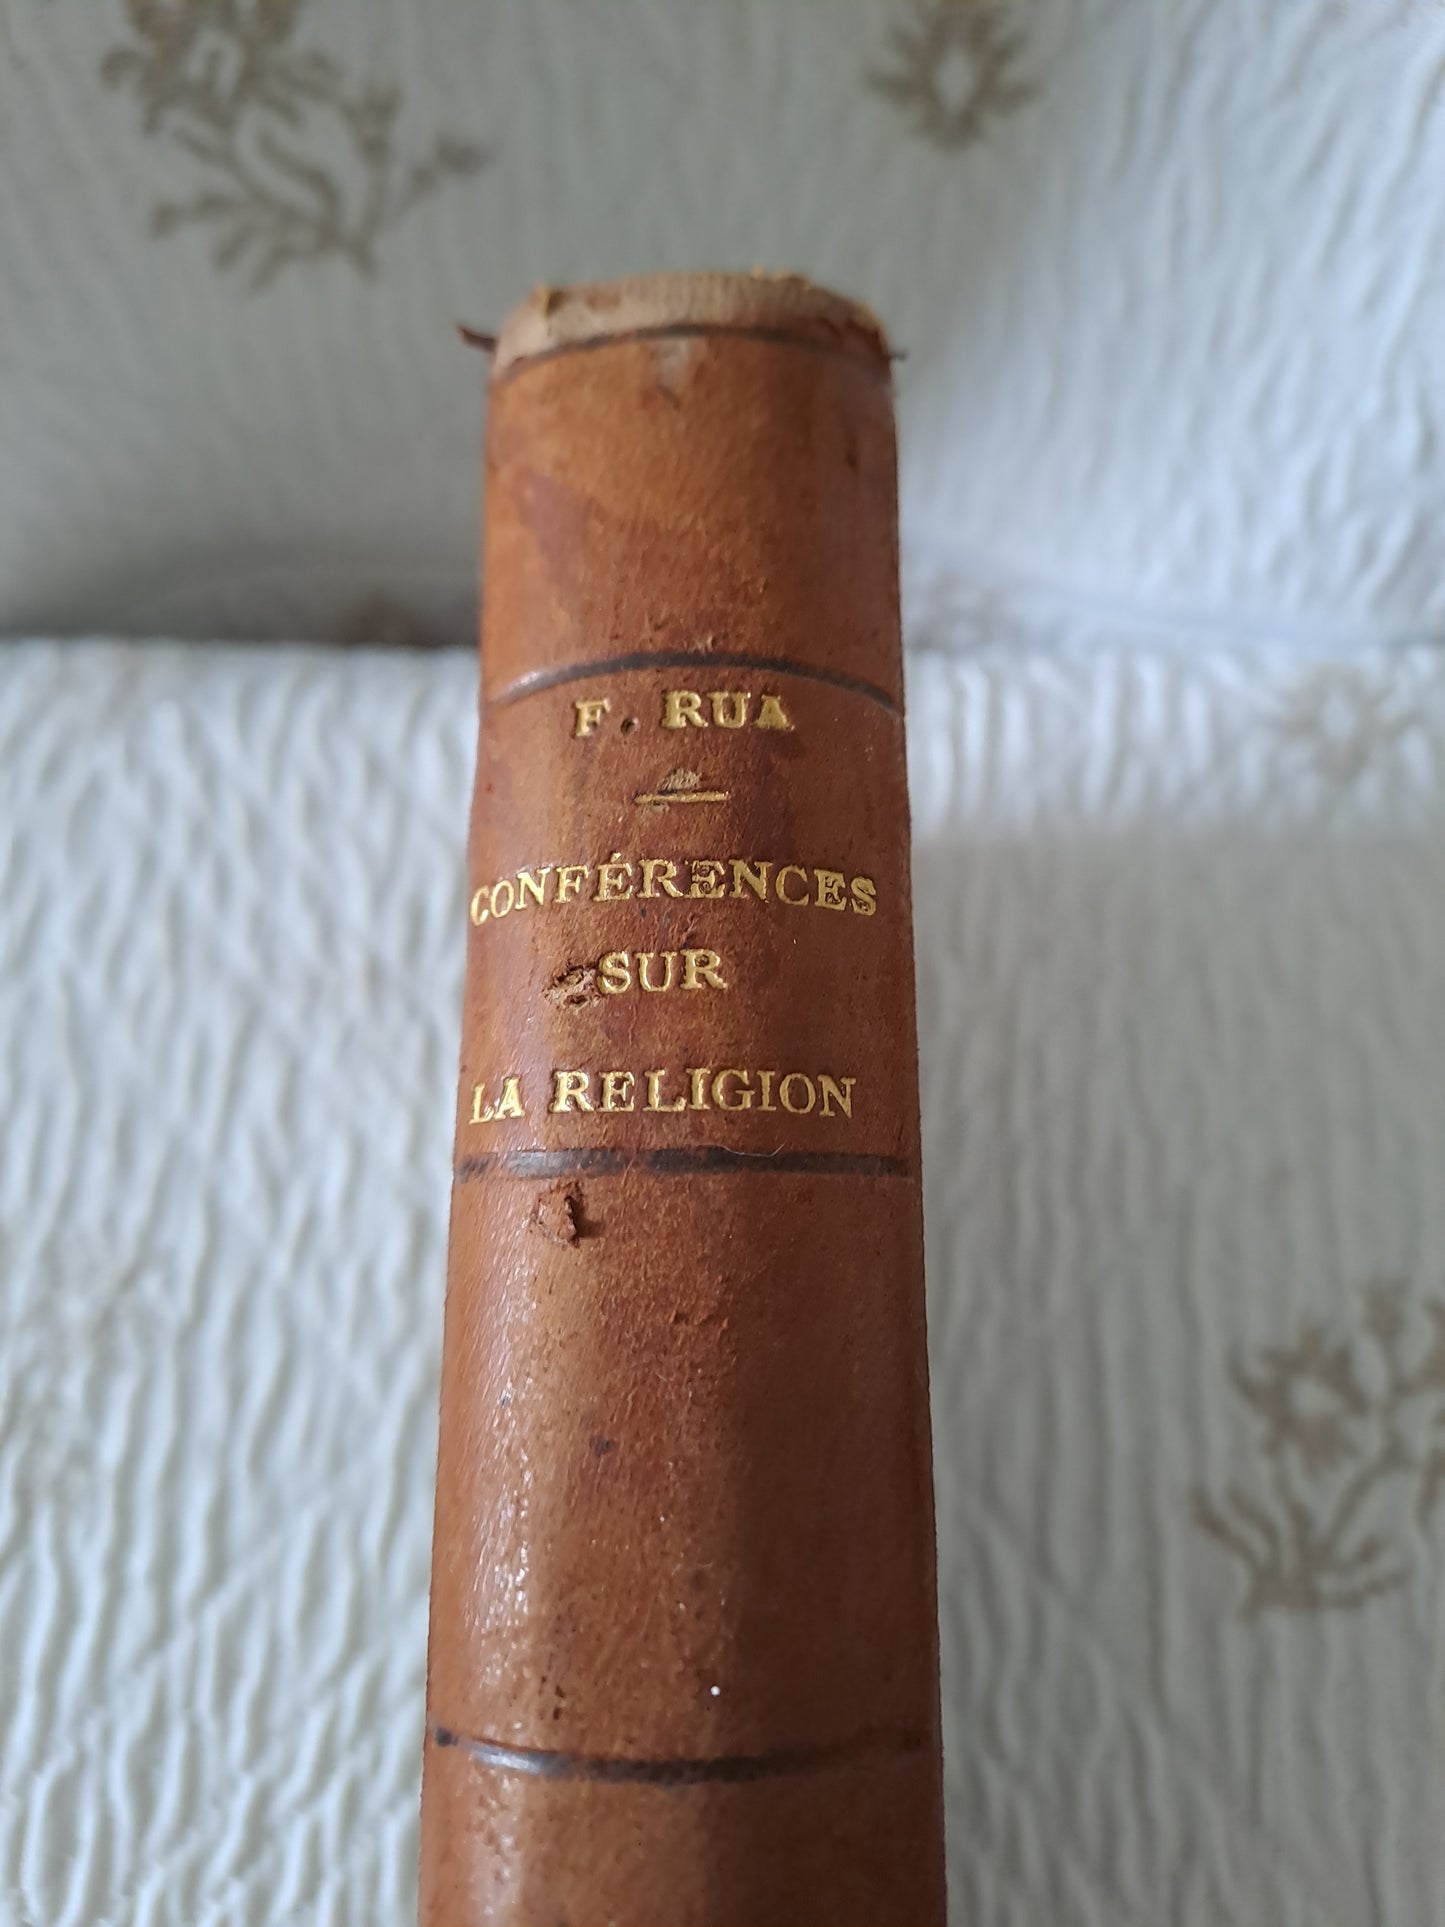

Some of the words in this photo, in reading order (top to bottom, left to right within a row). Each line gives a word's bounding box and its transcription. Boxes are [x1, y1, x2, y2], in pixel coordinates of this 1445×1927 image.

[574, 698, 638, 738] F.
[661, 690, 795, 732] RUA
[470, 852, 877, 928] CONFÉRENCES
[598, 948, 727, 995] SUR
[469, 1077, 525, 1125] LA
[548, 1067, 856, 1118] RELIGION
